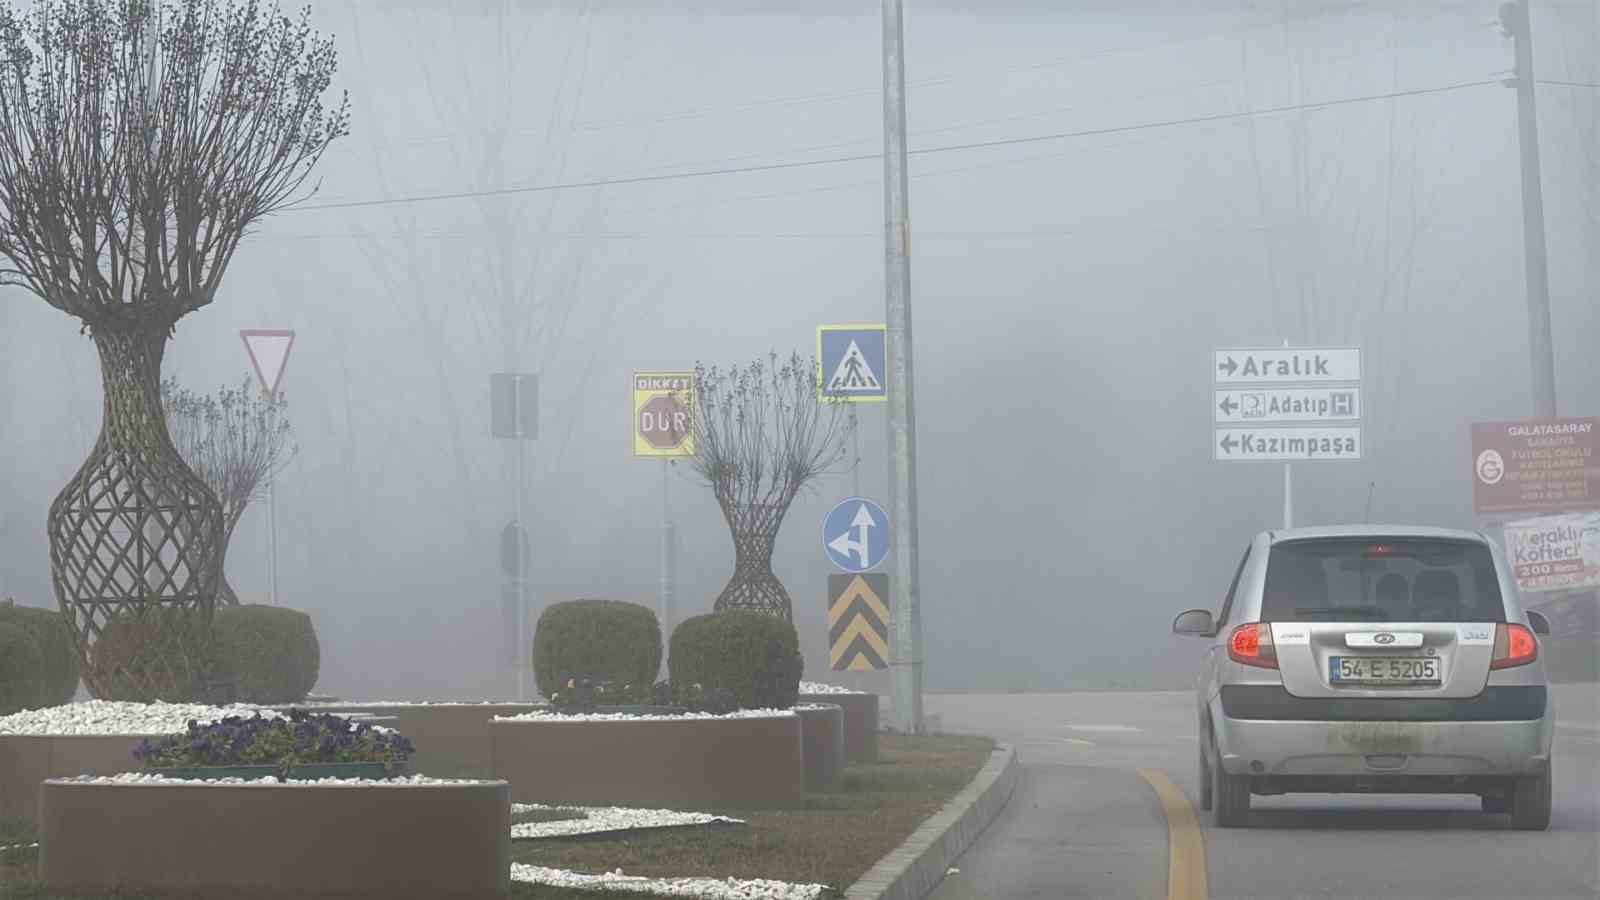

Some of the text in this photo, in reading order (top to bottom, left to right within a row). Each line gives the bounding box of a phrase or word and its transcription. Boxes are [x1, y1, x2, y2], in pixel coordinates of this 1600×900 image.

[1242, 355, 1329, 377] Aralık
[1269, 396, 1328, 416] Adatıp
[642, 411, 686, 432] DUR
[1508, 423, 1593, 436] GALATASARAY
[1241, 433, 1356, 457] Kazımpaşa
[1520, 564, 1551, 577] 200
[1341, 660, 1363, 677] 54
[1370, 660, 1382, 678] E
[1389, 660, 1435, 678] 5205
